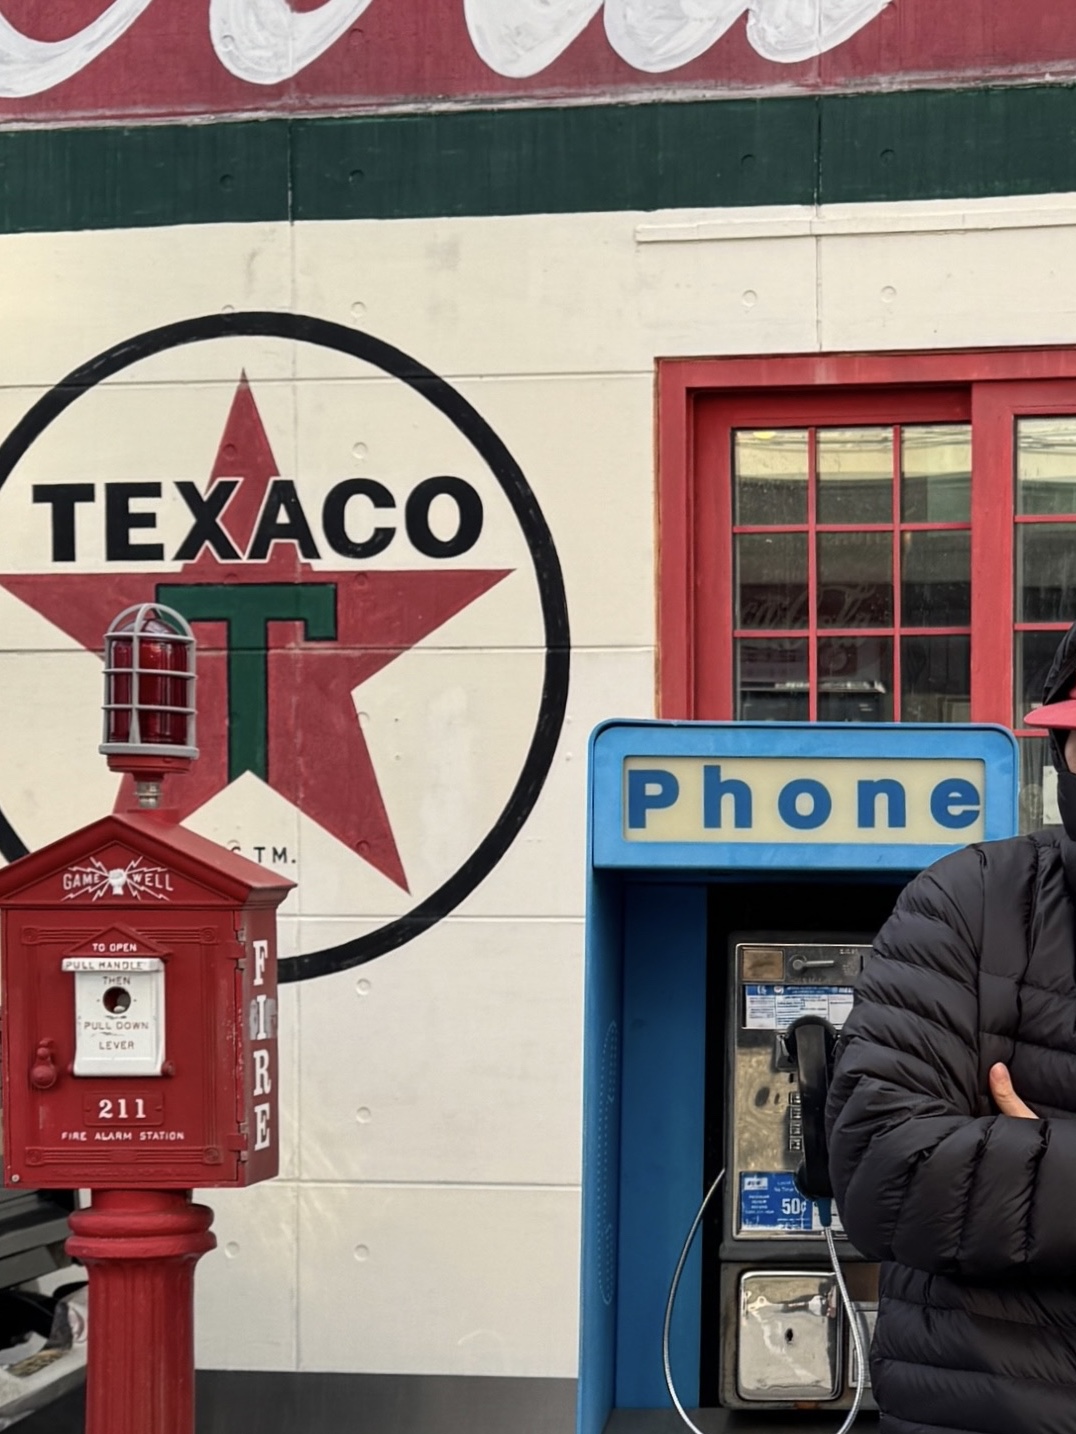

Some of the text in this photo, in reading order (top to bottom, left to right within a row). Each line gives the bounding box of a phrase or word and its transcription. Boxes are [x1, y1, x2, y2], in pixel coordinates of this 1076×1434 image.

[32, 475, 484, 563] TEXACO
[627, 764, 981, 830] Phone
[63, 873, 174, 891] GAME WELL
[92, 943, 137, 952] TO OPEN
[65, 961, 143, 970] PULL HANDLE
[103, 976, 131, 985] THEN
[84, 1021, 149, 1030] PULL DOWN
[99, 1041, 134, 1050] LEVER
[252, 939, 272, 1151] FIRE
[98, 1098, 146, 1118] 211
[61, 1131, 185, 1141] FIRE ALARM STATION
